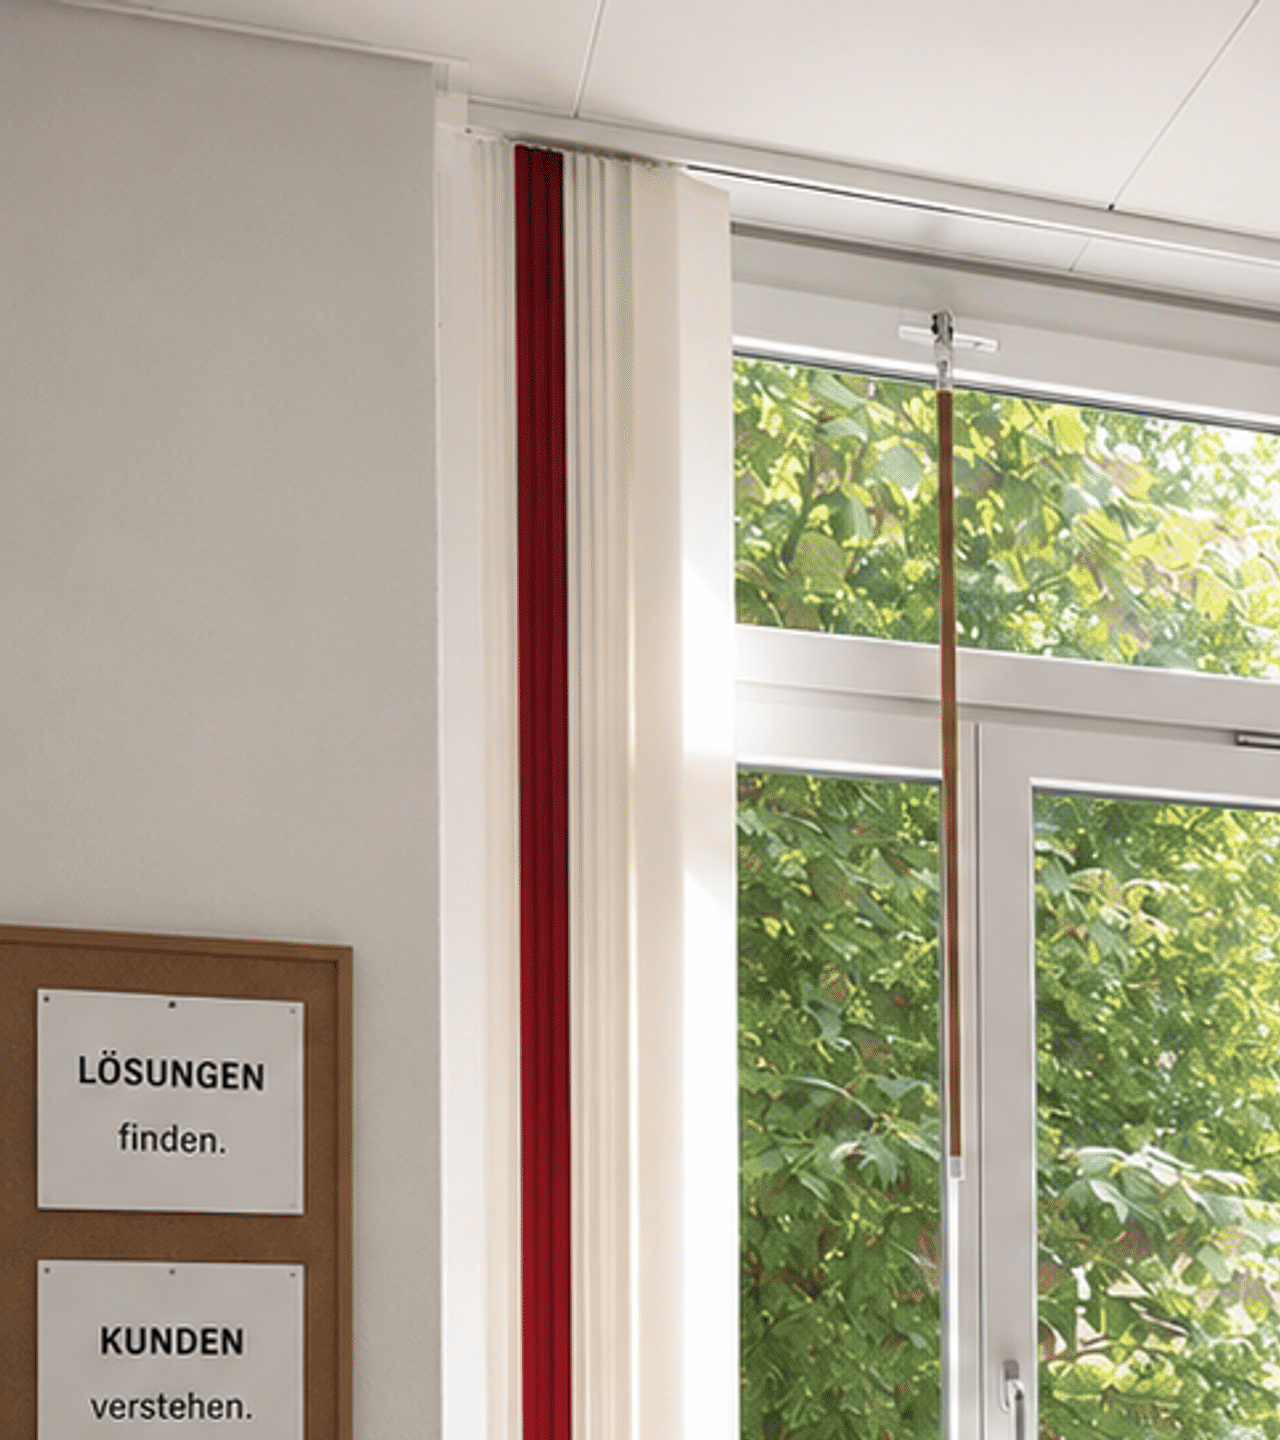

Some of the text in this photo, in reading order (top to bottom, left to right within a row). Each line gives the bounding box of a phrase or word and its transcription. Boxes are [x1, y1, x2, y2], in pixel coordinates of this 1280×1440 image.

[79, 1050, 264, 1090] LÖSUNGEN
[118, 1122, 225, 1154] finden.
[101, 1326, 243, 1355] KUNDEN
[91, 1392, 252, 1419] verstehen.
